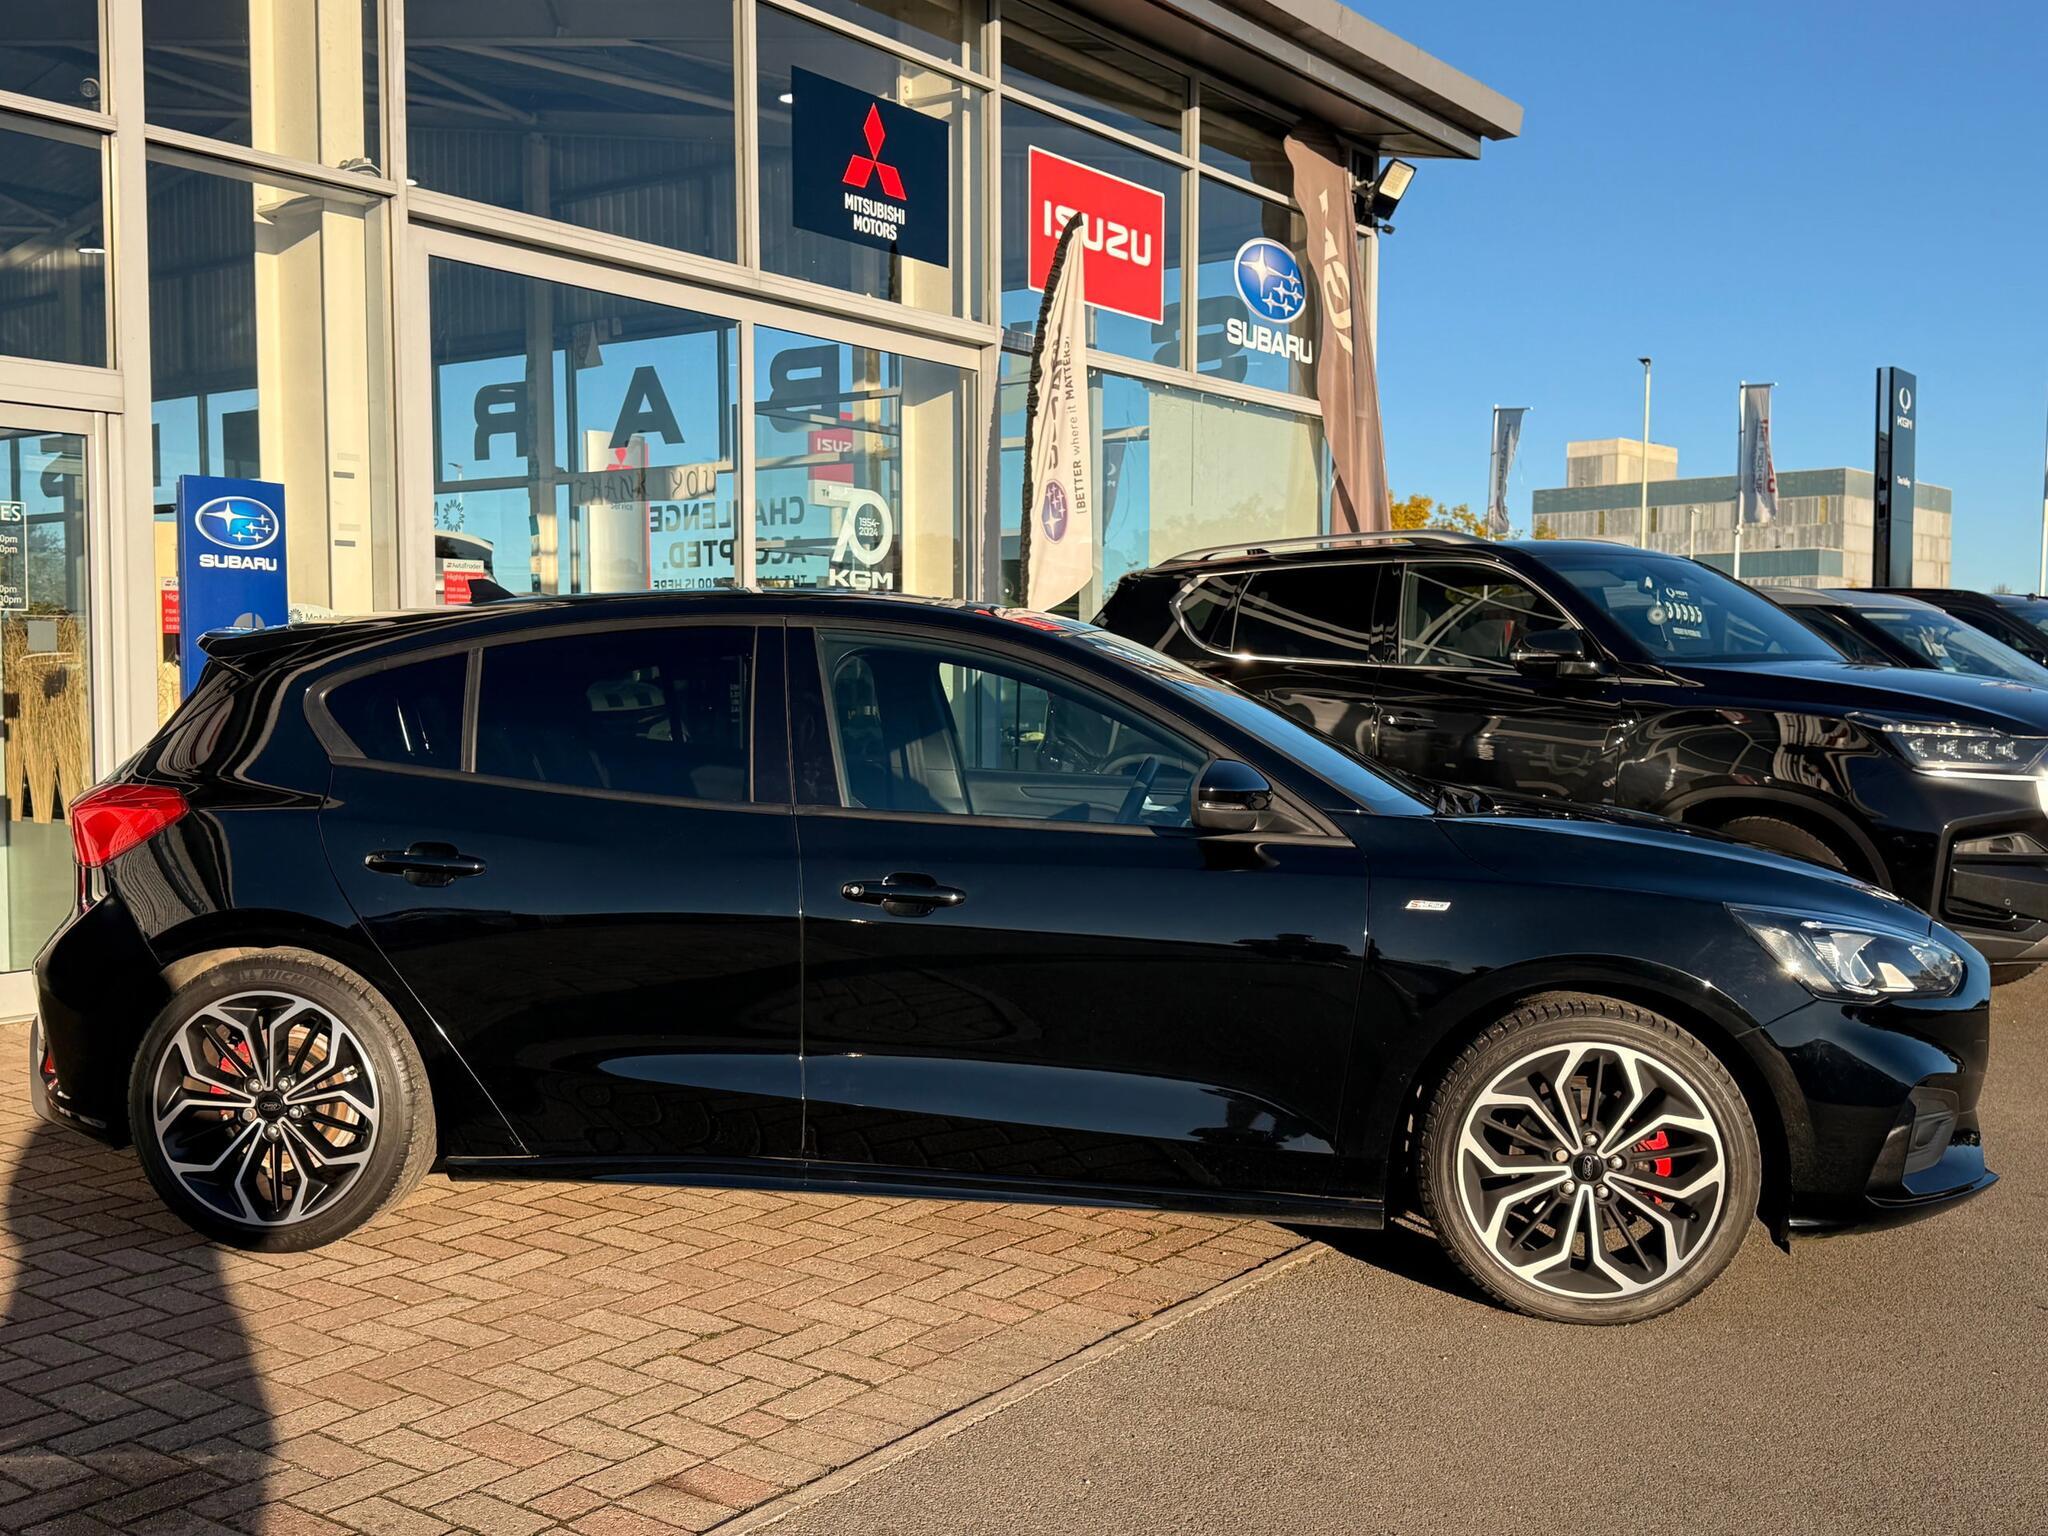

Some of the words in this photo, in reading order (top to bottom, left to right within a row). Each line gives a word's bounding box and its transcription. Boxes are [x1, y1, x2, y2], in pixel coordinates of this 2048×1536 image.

[844, 193, 905, 224] MITSUBISHI
[853, 213, 897, 240] MOTORS
[1226, 318, 1313, 365] SUBARU
[1066, 404, 1076, 414] it
[1069, 416, 1081, 456] where
[575, 471, 647, 504] THANK
[670, 470, 716, 497] YOU
[859, 526, 879, 536] 2024
[199, 554, 277, 571] SUBARU
[829, 569, 893, 591] KGM
